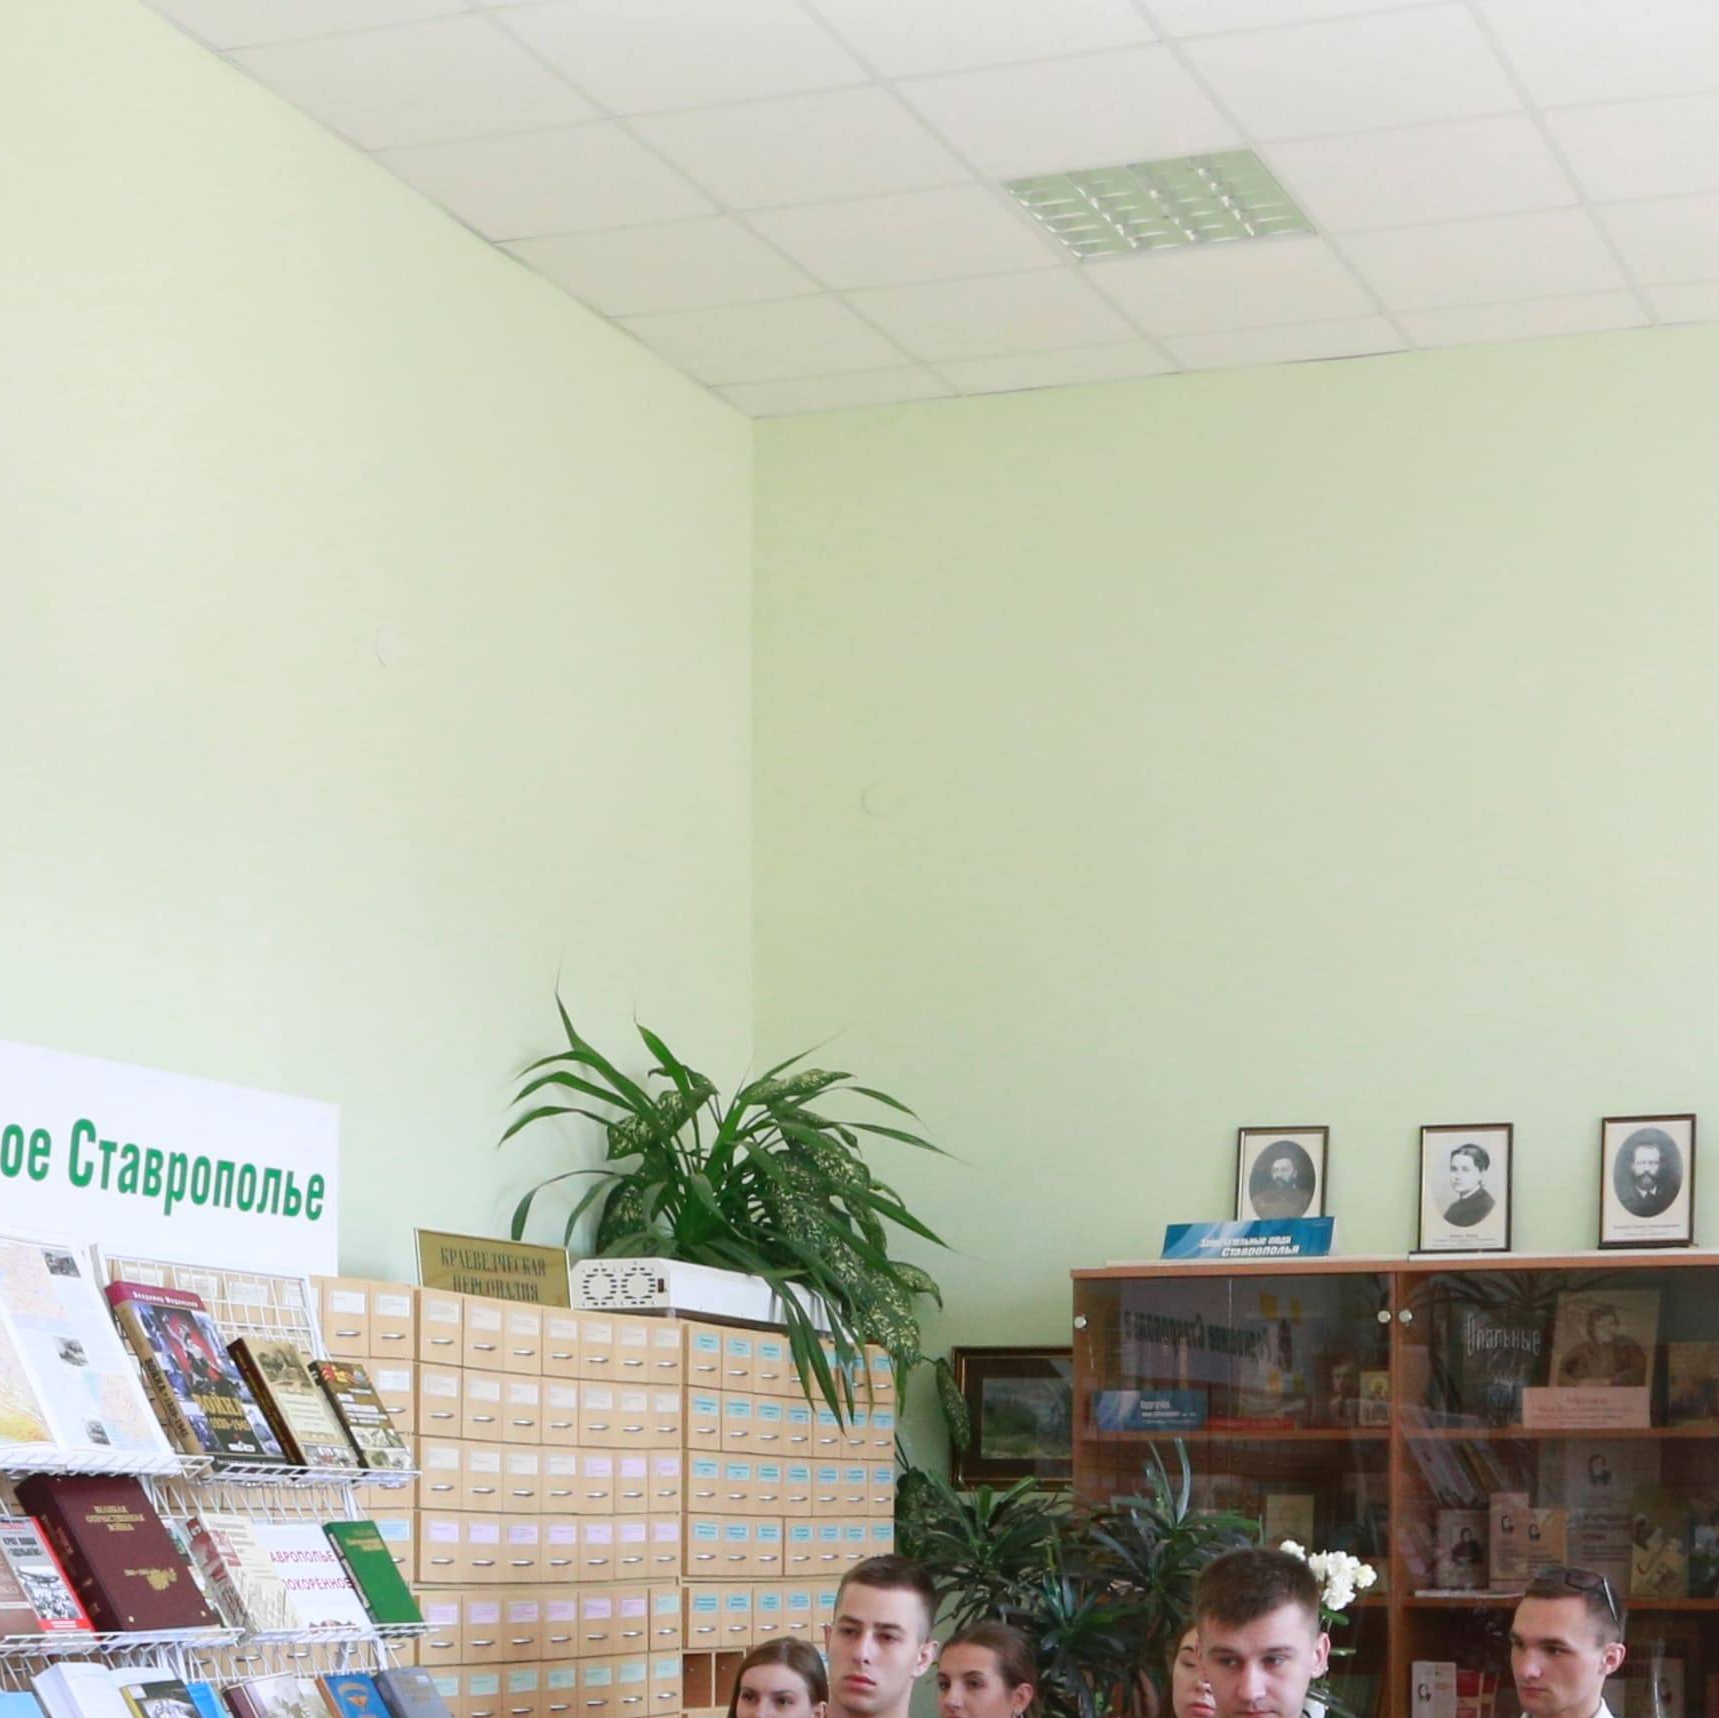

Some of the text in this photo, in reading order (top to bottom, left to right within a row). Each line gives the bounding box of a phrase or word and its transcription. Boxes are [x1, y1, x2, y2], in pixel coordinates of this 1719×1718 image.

[67, 1117, 328, 1223] Ставрополье
[1222, 1244, 1300, 1257] Ставрополья
[441, 1247, 546, 1278] КРАЕВЕДЧЕСКАЯ
[270, 1551, 337, 1563] АВРОПОЛЬЕ
